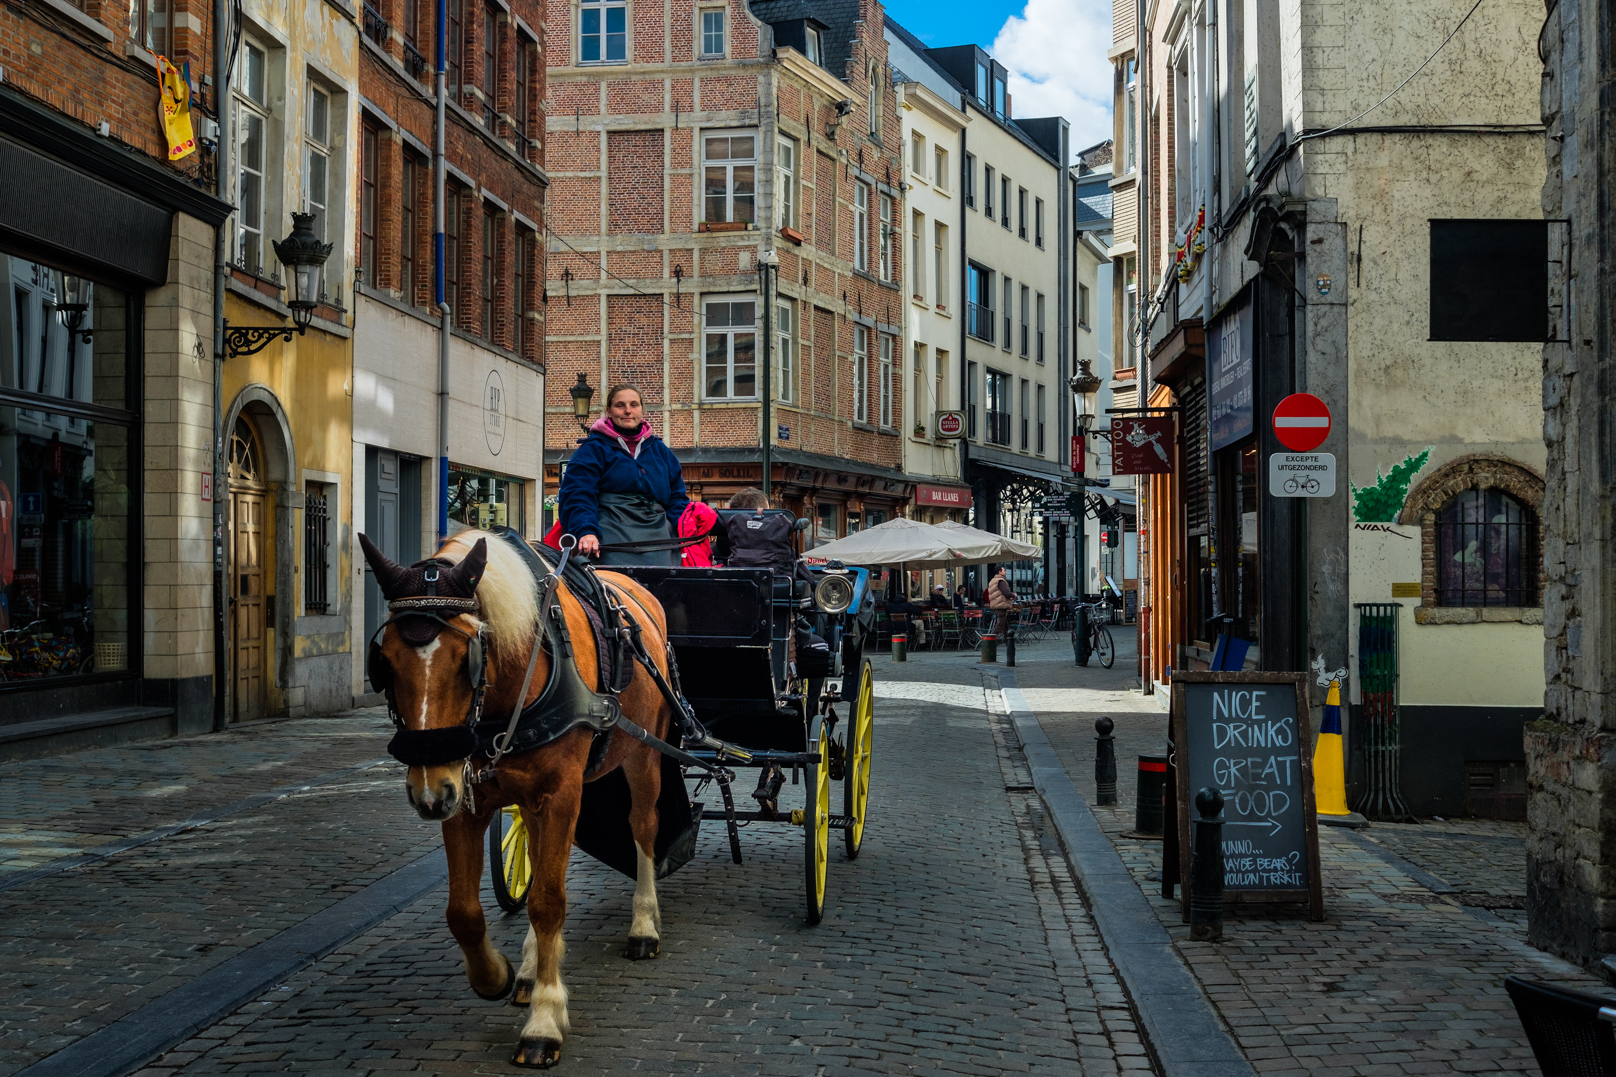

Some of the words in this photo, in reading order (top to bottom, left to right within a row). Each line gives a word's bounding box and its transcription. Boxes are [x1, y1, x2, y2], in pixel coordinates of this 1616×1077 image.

[1113, 420, 1124, 474] TATTOO
[719, 468, 753, 478] SOLEIL
[203, 477, 210, 496] H
[932, 491, 942, 501] BAR
[942, 492, 959, 503] LLANES
[1354, 523, 1413, 540] NIAK
[1212, 689, 1267, 720] NICE
[1213, 755, 1299, 788] GREAT
[1219, 789, 1290, 818] FOOD
